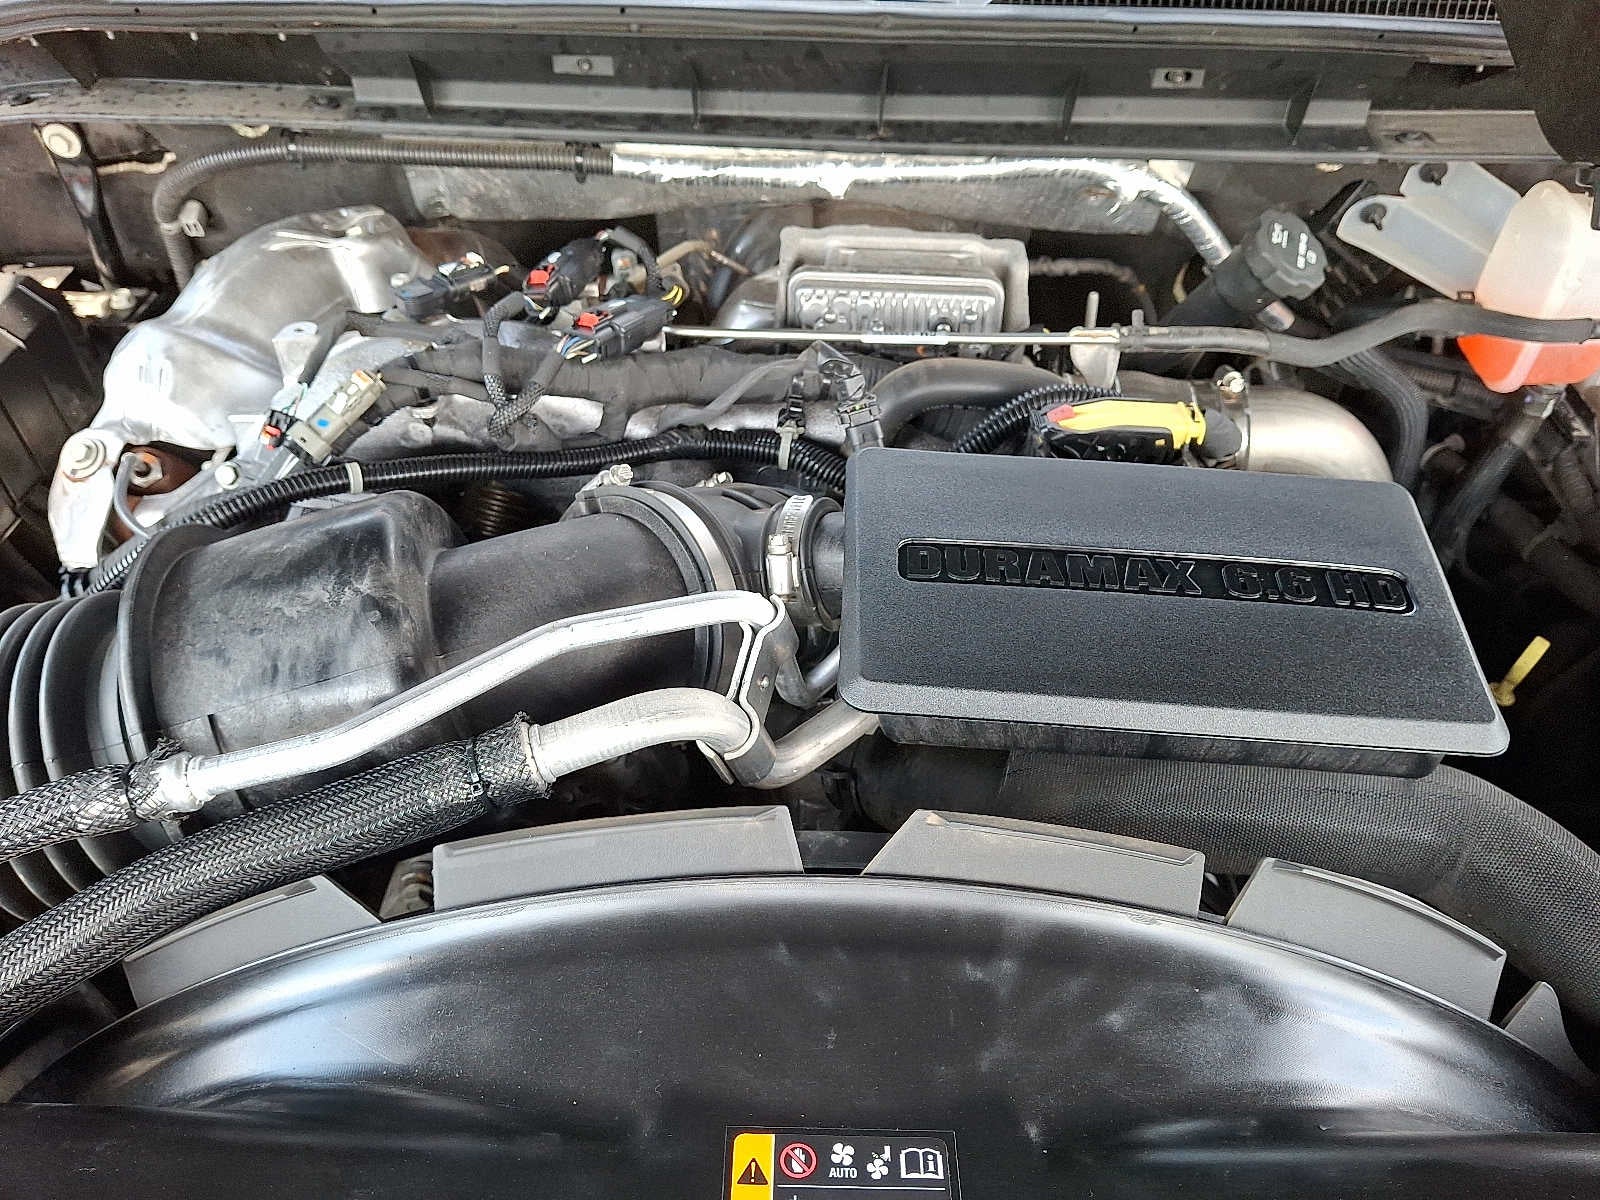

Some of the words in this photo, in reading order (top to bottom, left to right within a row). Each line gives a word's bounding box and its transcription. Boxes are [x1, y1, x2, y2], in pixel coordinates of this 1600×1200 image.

[907, 546, 1201, 594] DURAMAX
[1223, 564, 1317, 602] 6.6
[1325, 570, 1408, 610] HD
[828, 1167, 858, 1178] AUTO
